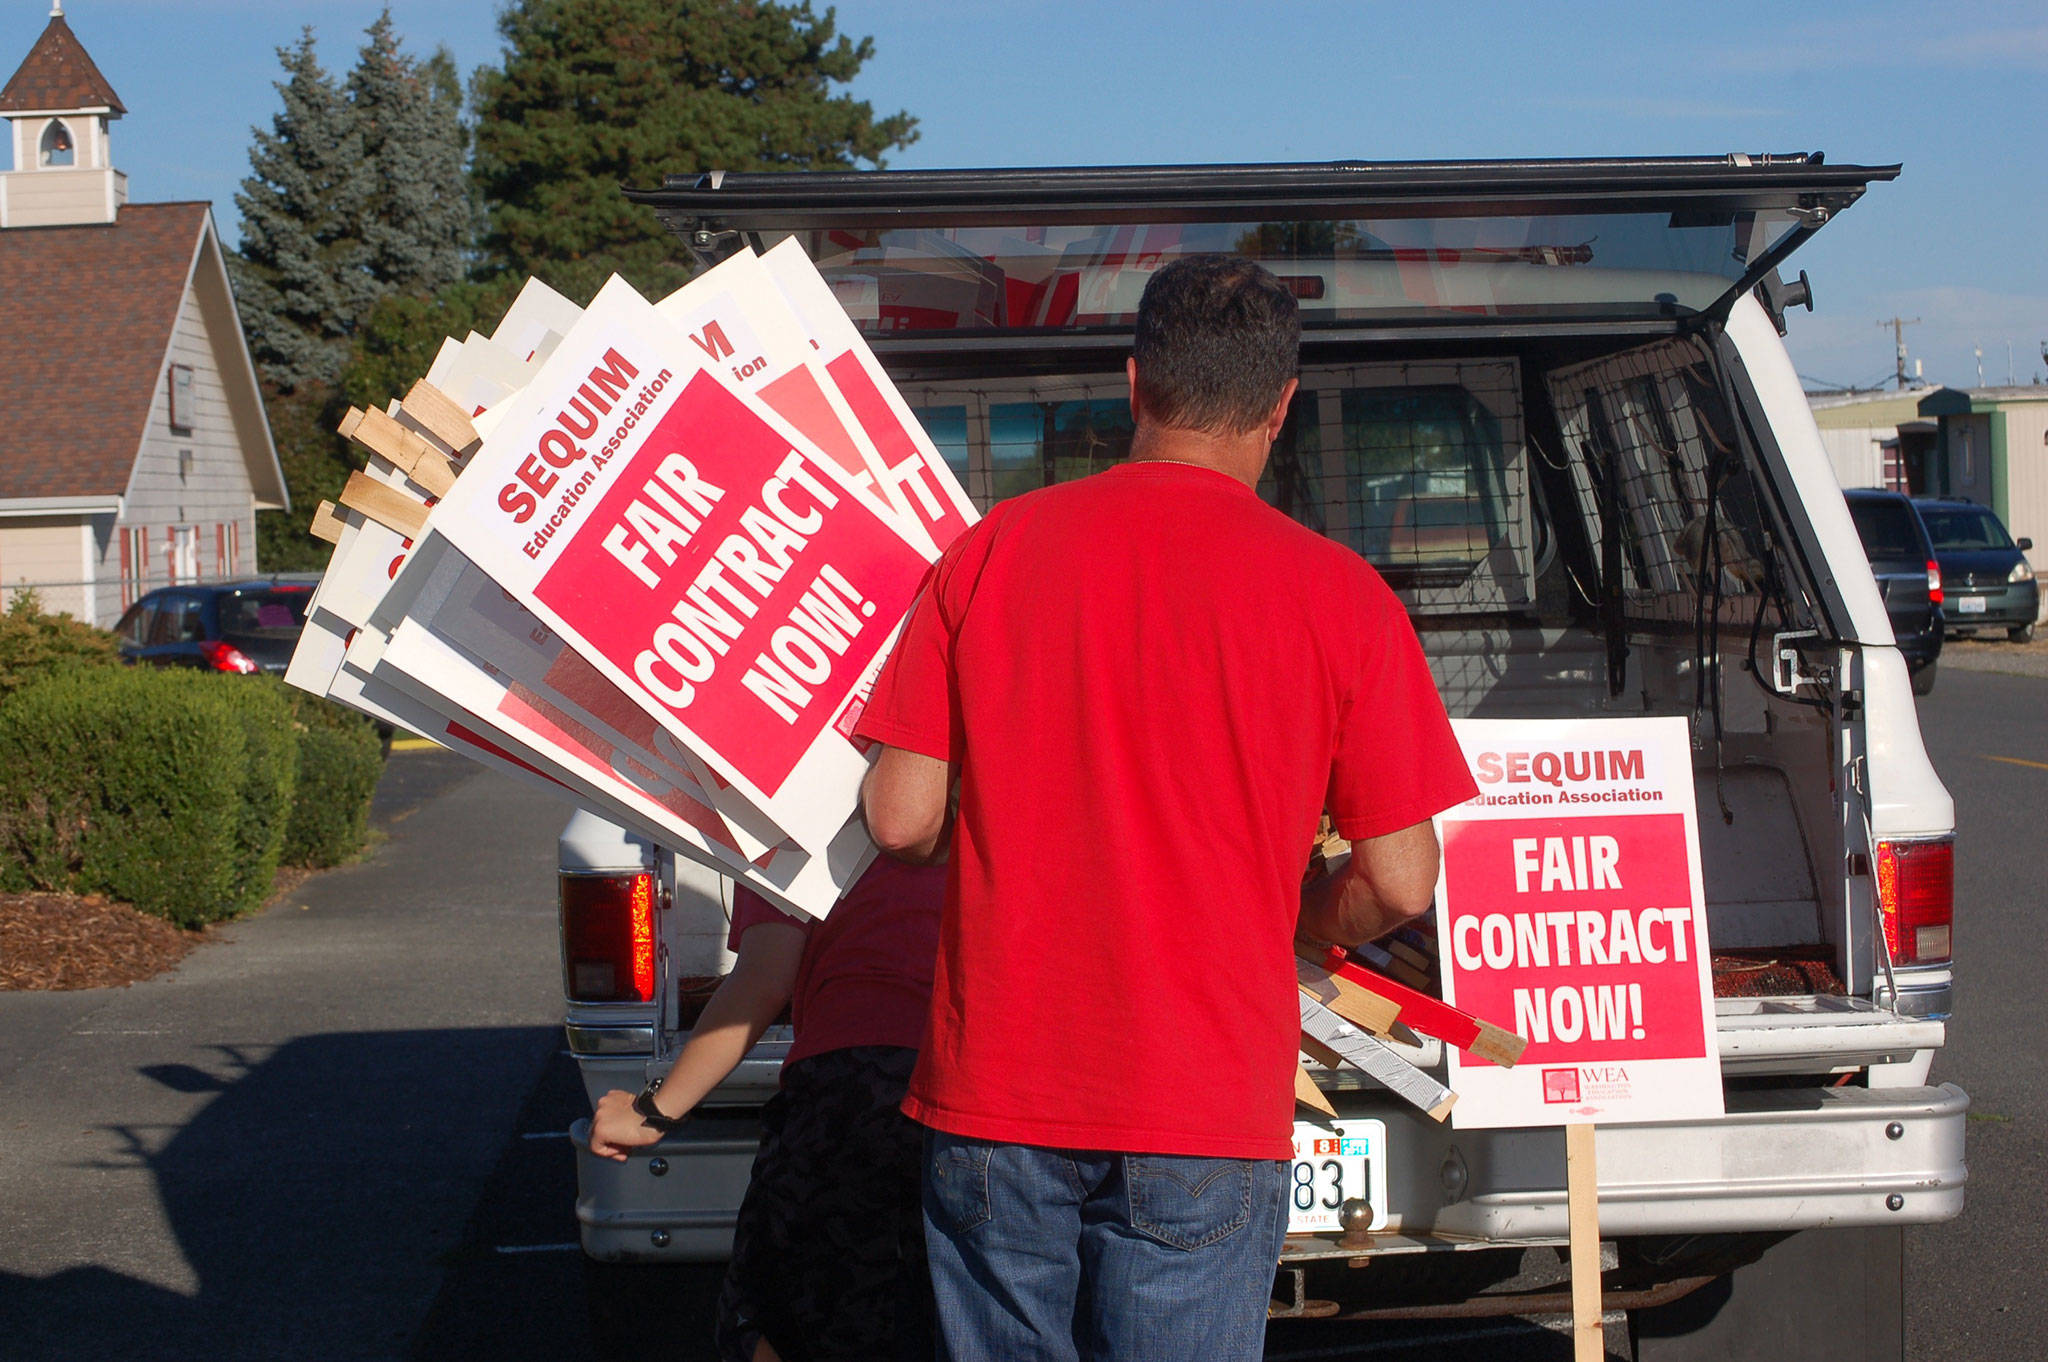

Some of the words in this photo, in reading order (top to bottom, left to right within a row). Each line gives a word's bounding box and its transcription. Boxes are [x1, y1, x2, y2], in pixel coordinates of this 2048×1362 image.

[498, 347, 639, 524] SEQUIM
[522, 470, 596, 560] Education
[590, 368, 673, 472] Association
[601, 452, 726, 590] FAIR
[633, 449, 840, 709] CONTRACT
[740, 563, 877, 726] NOW!
[1476, 750, 1645, 787] SEQUIM
[1558, 788, 1663, 804] Association
[1512, 835, 1623, 893] FAIR
[1453, 907, 1691, 971] CONTRACT
[1513, 983, 1646, 1043] NOW!
[1582, 1067, 1629, 1083] WEA
